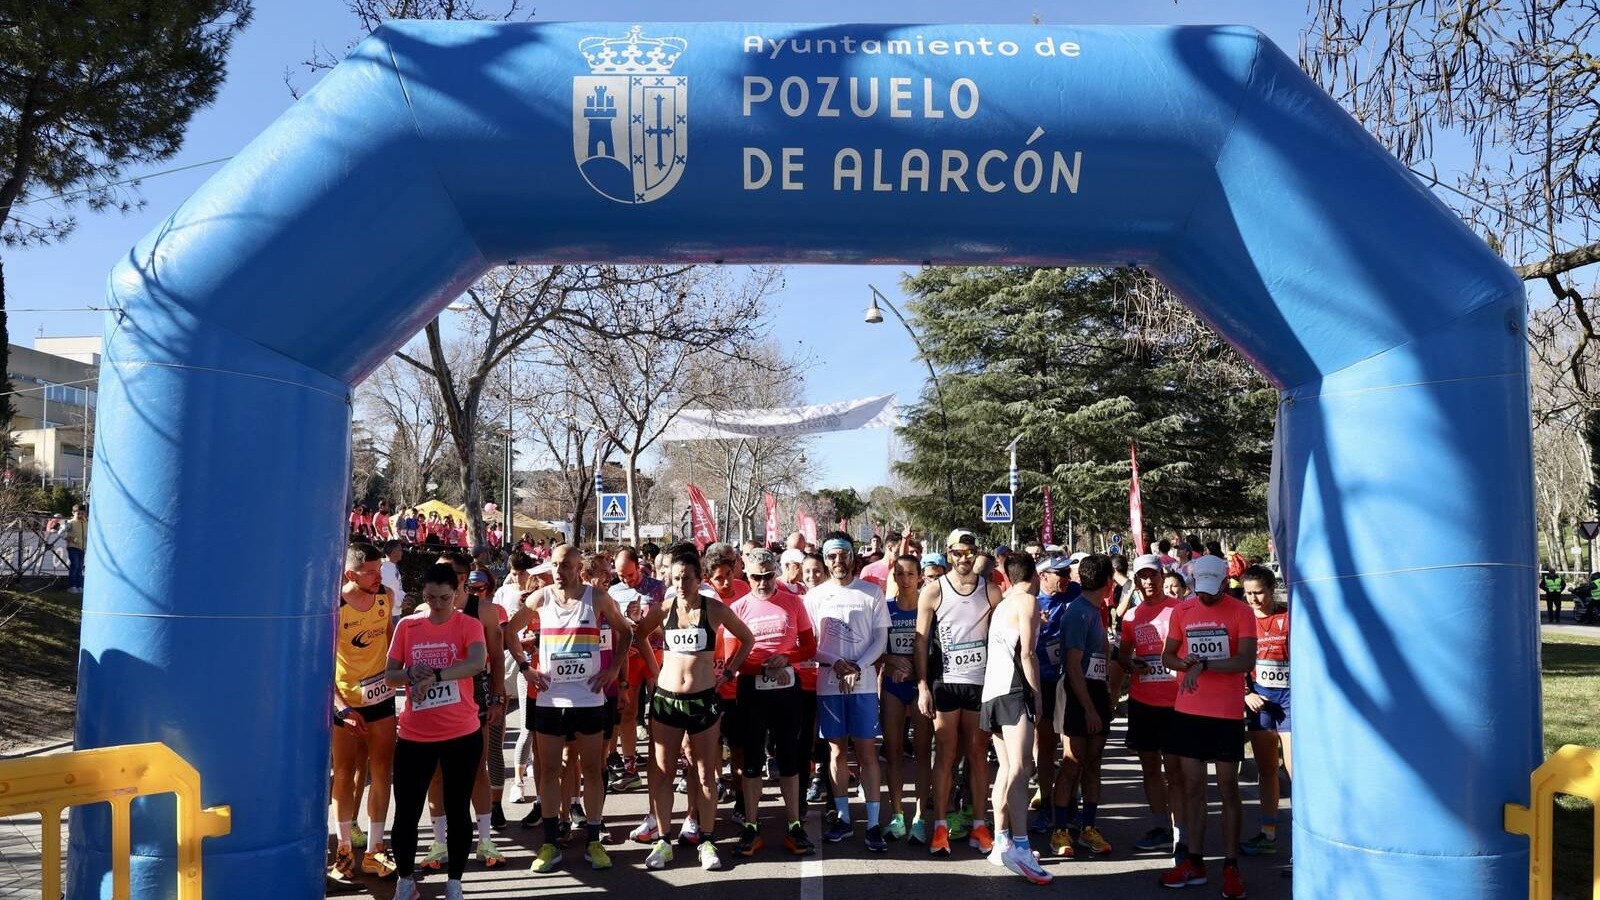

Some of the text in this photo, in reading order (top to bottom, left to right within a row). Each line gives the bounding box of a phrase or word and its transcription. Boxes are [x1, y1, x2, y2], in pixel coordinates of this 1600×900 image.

[743, 35, 1081, 59] Ayuntamiento de
[742, 75, 980, 120] POZUELO
[742, 126, 1082, 194] DE ALARCÓN
[673, 633, 699, 645] 0161
[895, 637, 915, 647] 022
[1191, 642, 1223, 653] 0001
[955, 652, 982, 665] 0243
[557, 663, 586, 676] 0276
[1144, 665, 1171, 676] 030
[367, 684, 392, 700] 000
[424, 684, 452, 700] 071
